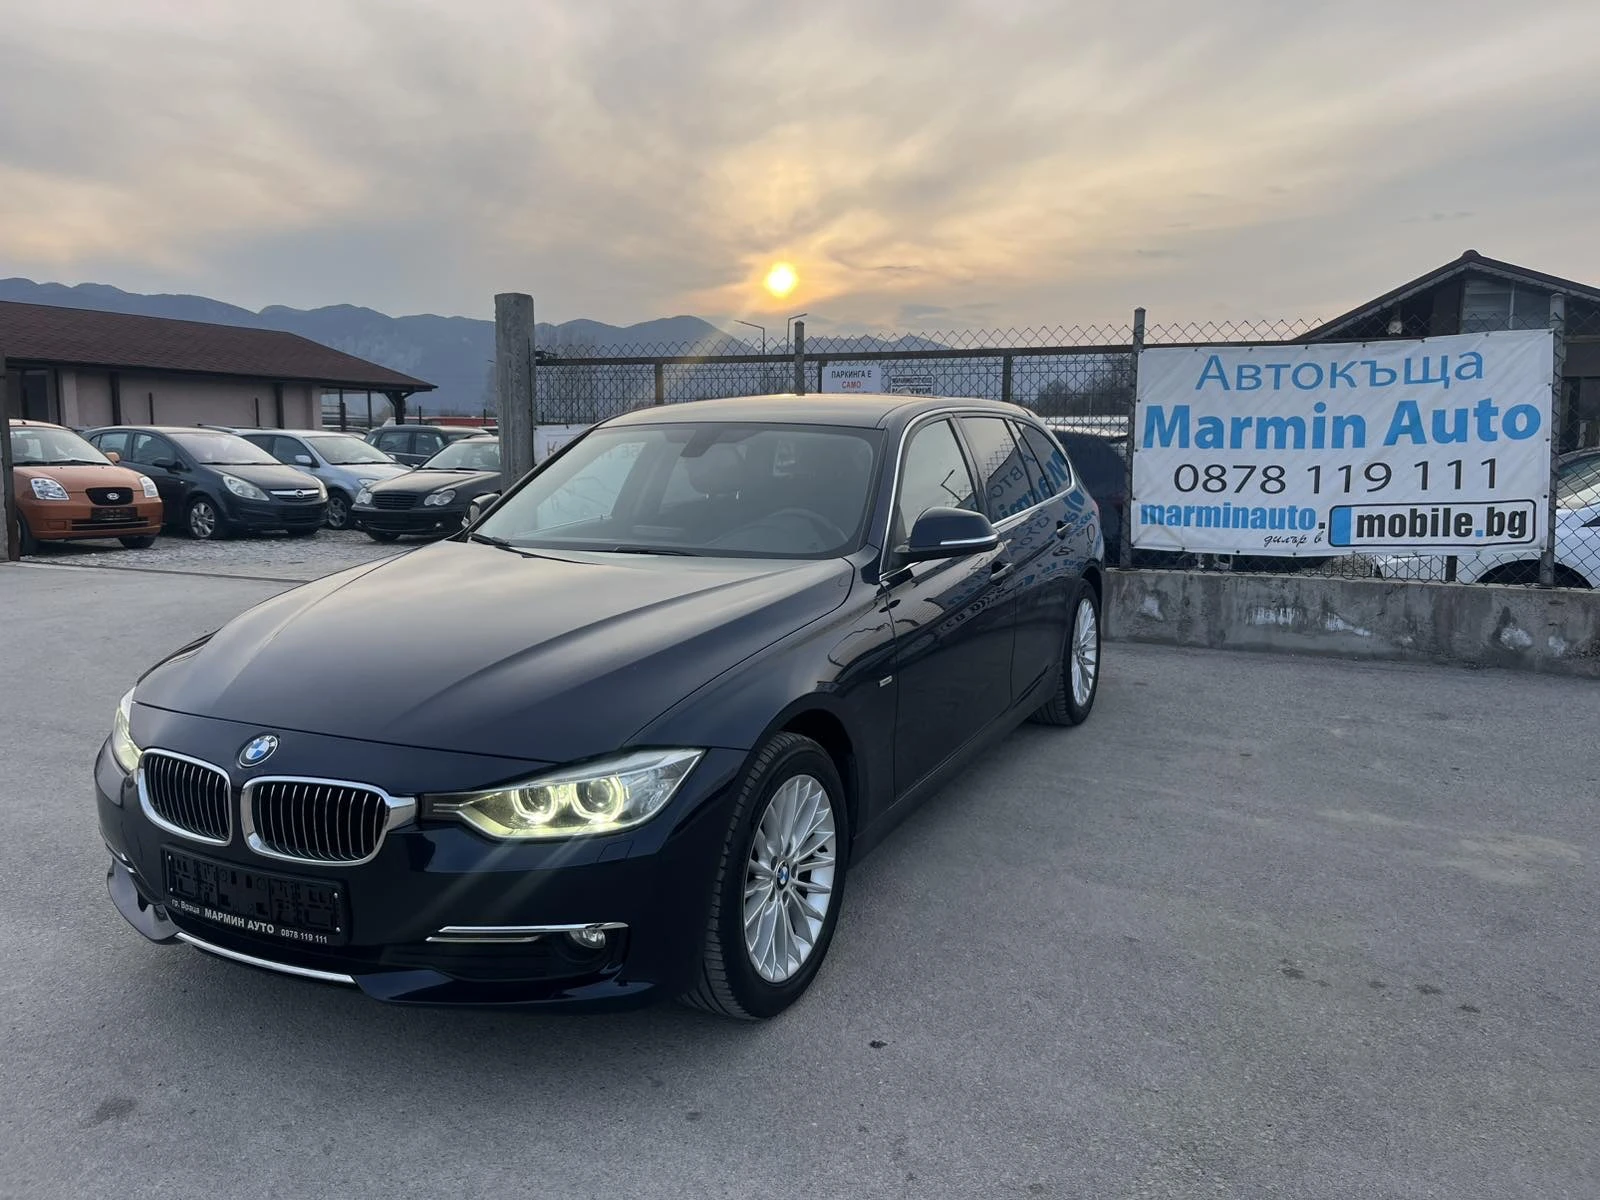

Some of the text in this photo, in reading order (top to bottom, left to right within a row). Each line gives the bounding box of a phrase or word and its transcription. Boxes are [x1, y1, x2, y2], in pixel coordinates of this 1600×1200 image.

[831, 370, 866, 379] ПАРКИНГА
[841, 380, 862, 389] САМО
[1194, 351, 1484, 390] Автокъща
[1142, 397, 1542, 450] Marmin Auto
[1173, 458, 1497, 495] 0878 119 111
[1356, 507, 1527, 539] mobile.bg
[204, 907, 245, 928] МАРМИН
[247, 919, 275, 934] АУТО
[280, 928, 299, 939] 0878
[300, 932, 314, 941] 119
[315, 934, 328, 944] 111
